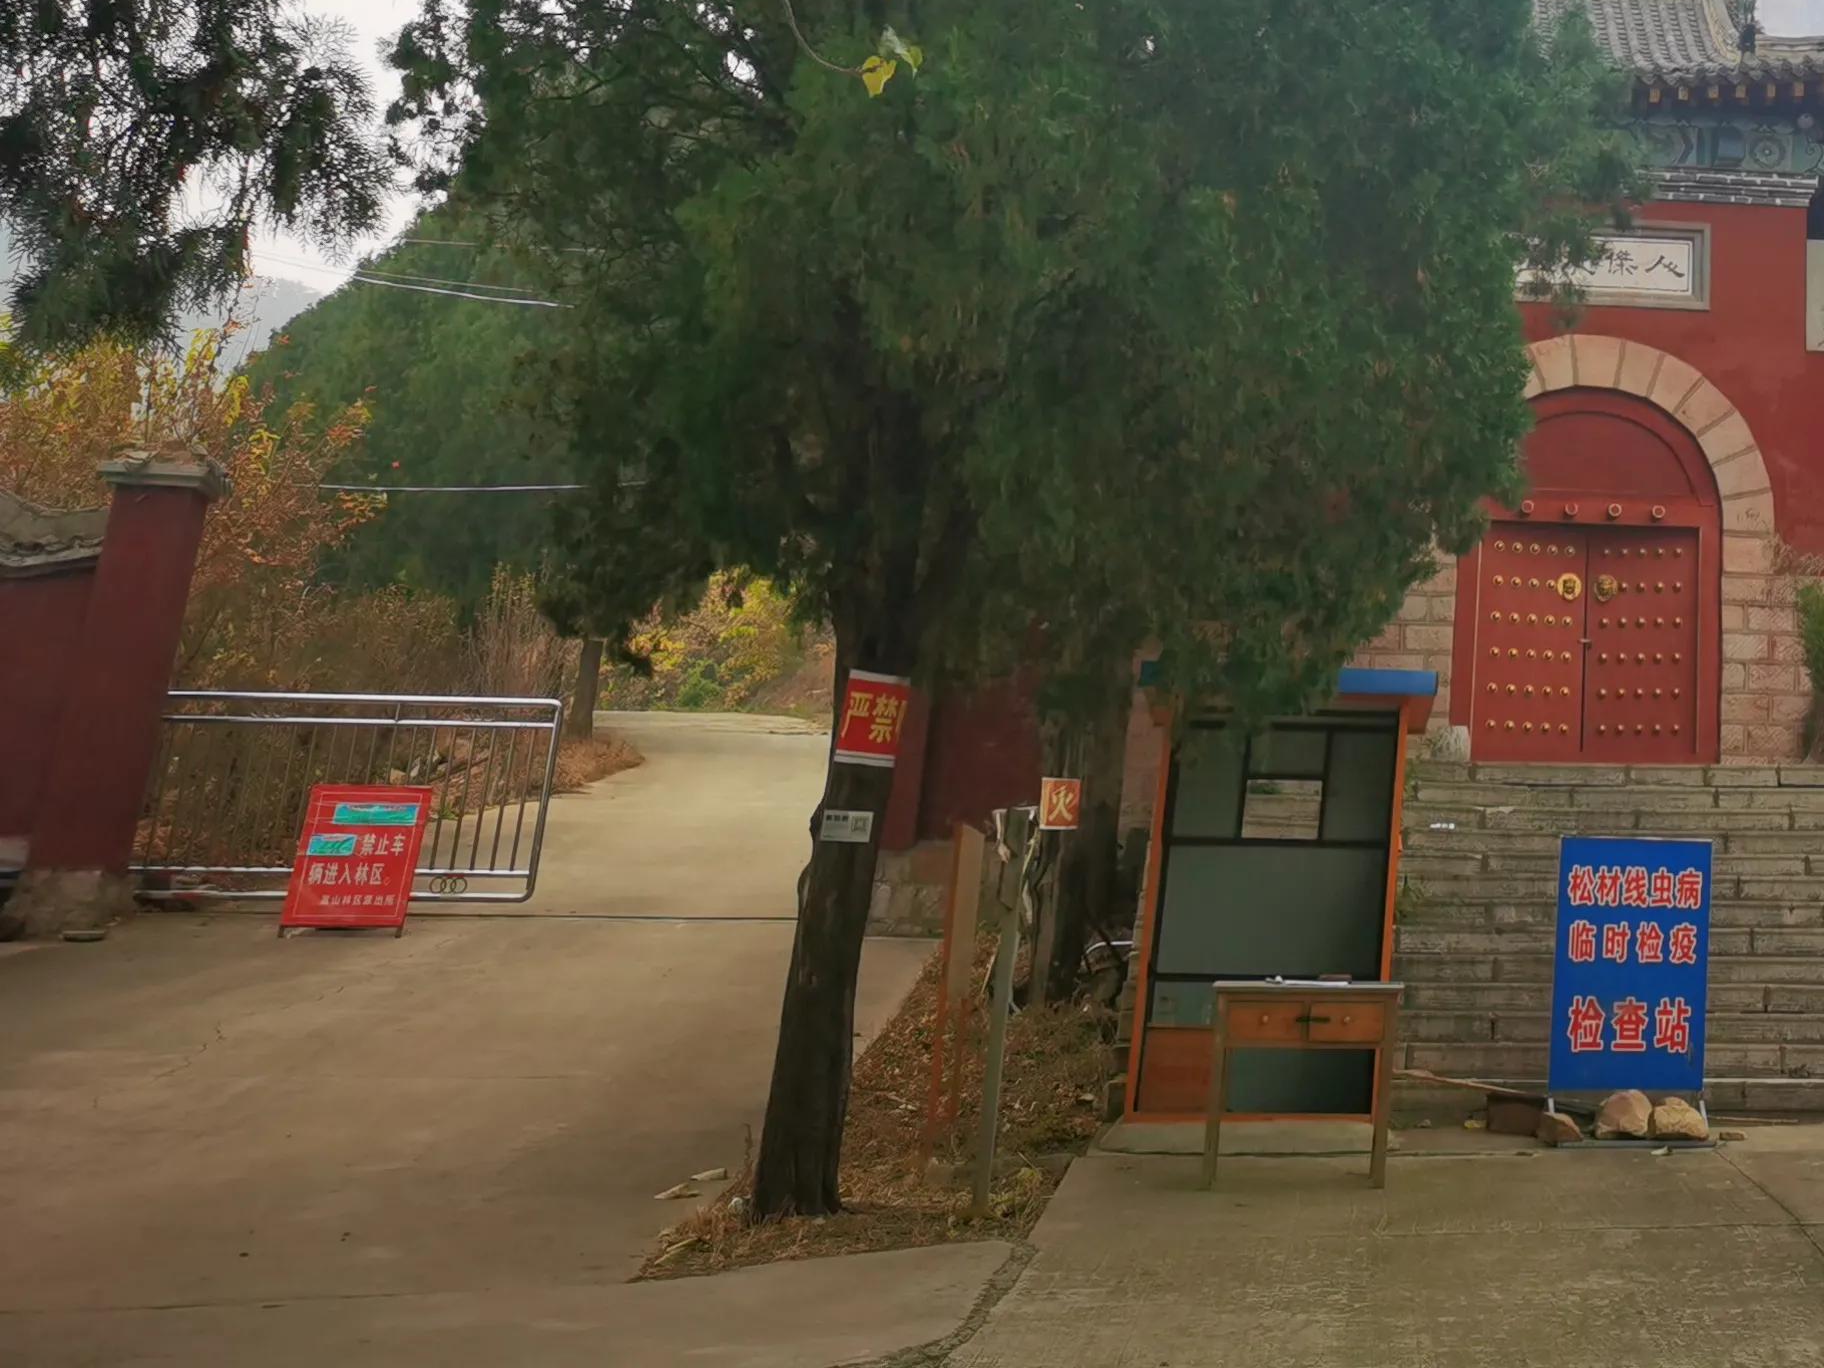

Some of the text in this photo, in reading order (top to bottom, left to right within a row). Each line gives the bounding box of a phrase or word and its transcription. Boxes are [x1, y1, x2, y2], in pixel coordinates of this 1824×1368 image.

[841, 692, 907, 743] 严禁
[360, 834, 406, 856] 禁止车
[1567, 865, 1702, 908] 松材线虫病
[1568, 920, 1697, 963] 临时检疫
[1567, 995, 1691, 1052] 检查站
